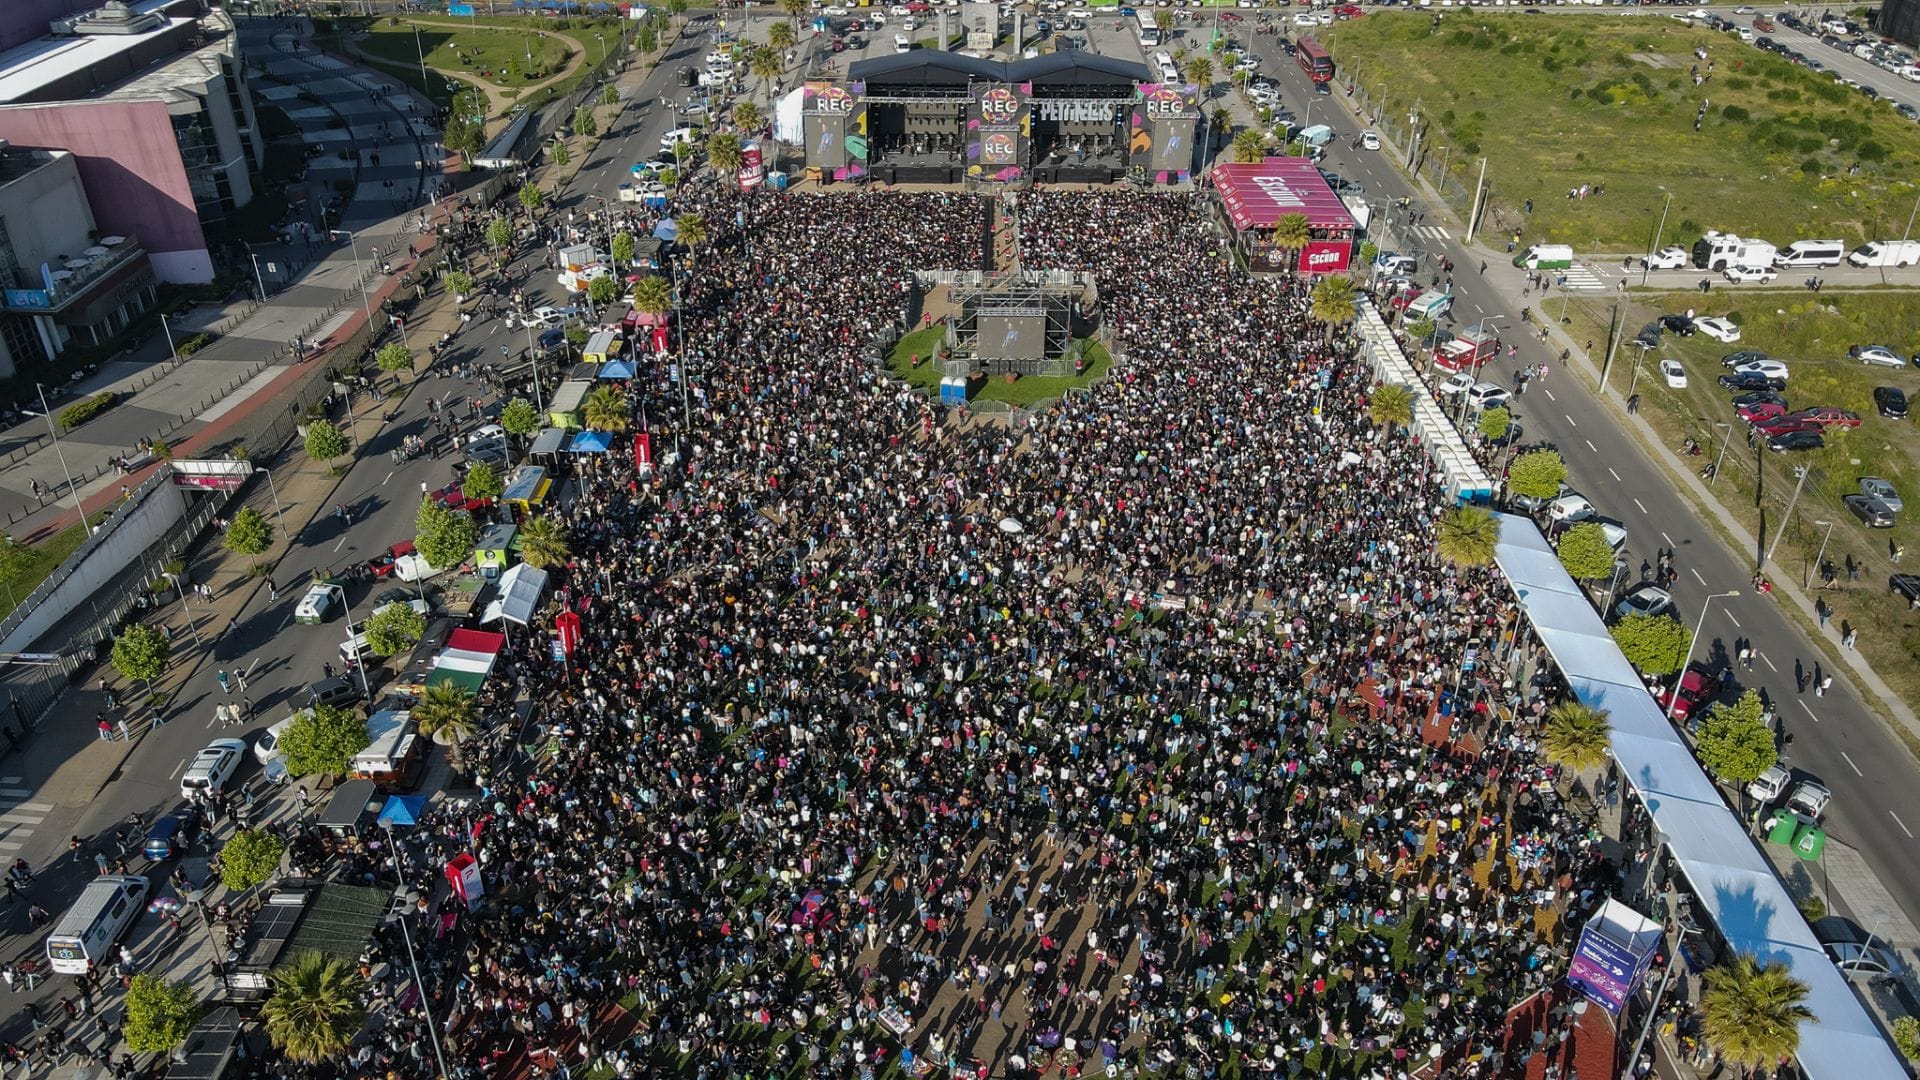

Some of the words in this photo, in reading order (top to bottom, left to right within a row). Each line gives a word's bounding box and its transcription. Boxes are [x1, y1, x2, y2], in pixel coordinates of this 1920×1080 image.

[817, 98, 853, 112] REC
[982, 100, 1018, 113] REC
[1147, 100, 1183, 113] REC
[985, 143, 1014, 154] REC
